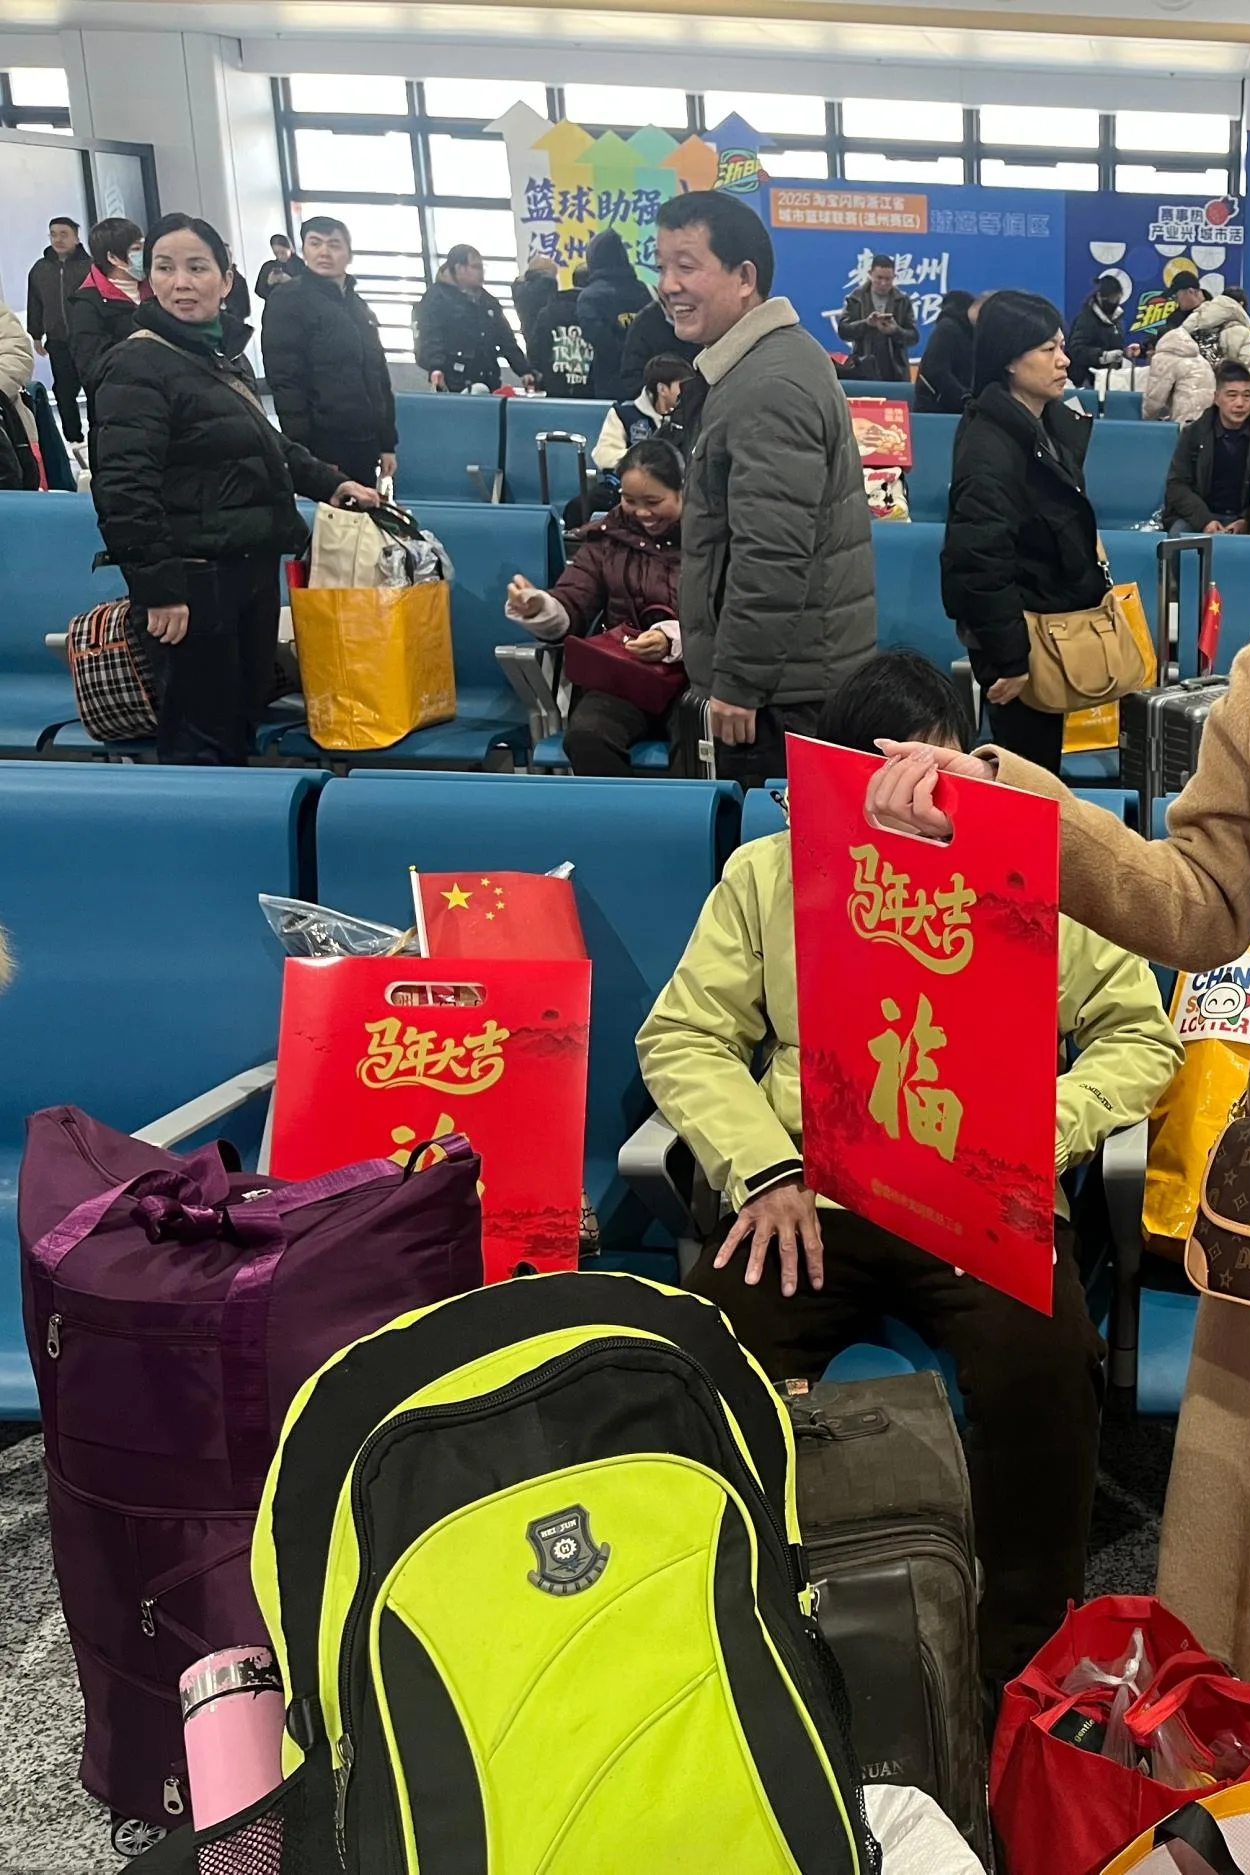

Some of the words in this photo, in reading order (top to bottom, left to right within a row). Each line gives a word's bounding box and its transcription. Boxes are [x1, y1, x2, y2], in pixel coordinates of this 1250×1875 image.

[714, 159, 760, 188] 浙B
[521, 176, 689, 228] 篮球助强
[778, 191, 811, 206] 2025
[528, 228, 660, 273] 温州迎
[848, 843, 977, 975] 马年大吉
[356, 1016, 510, 1095] 马年大吉
[867, 992, 963, 1162] 福
[1073, 1718, 1097, 1743] gentle
